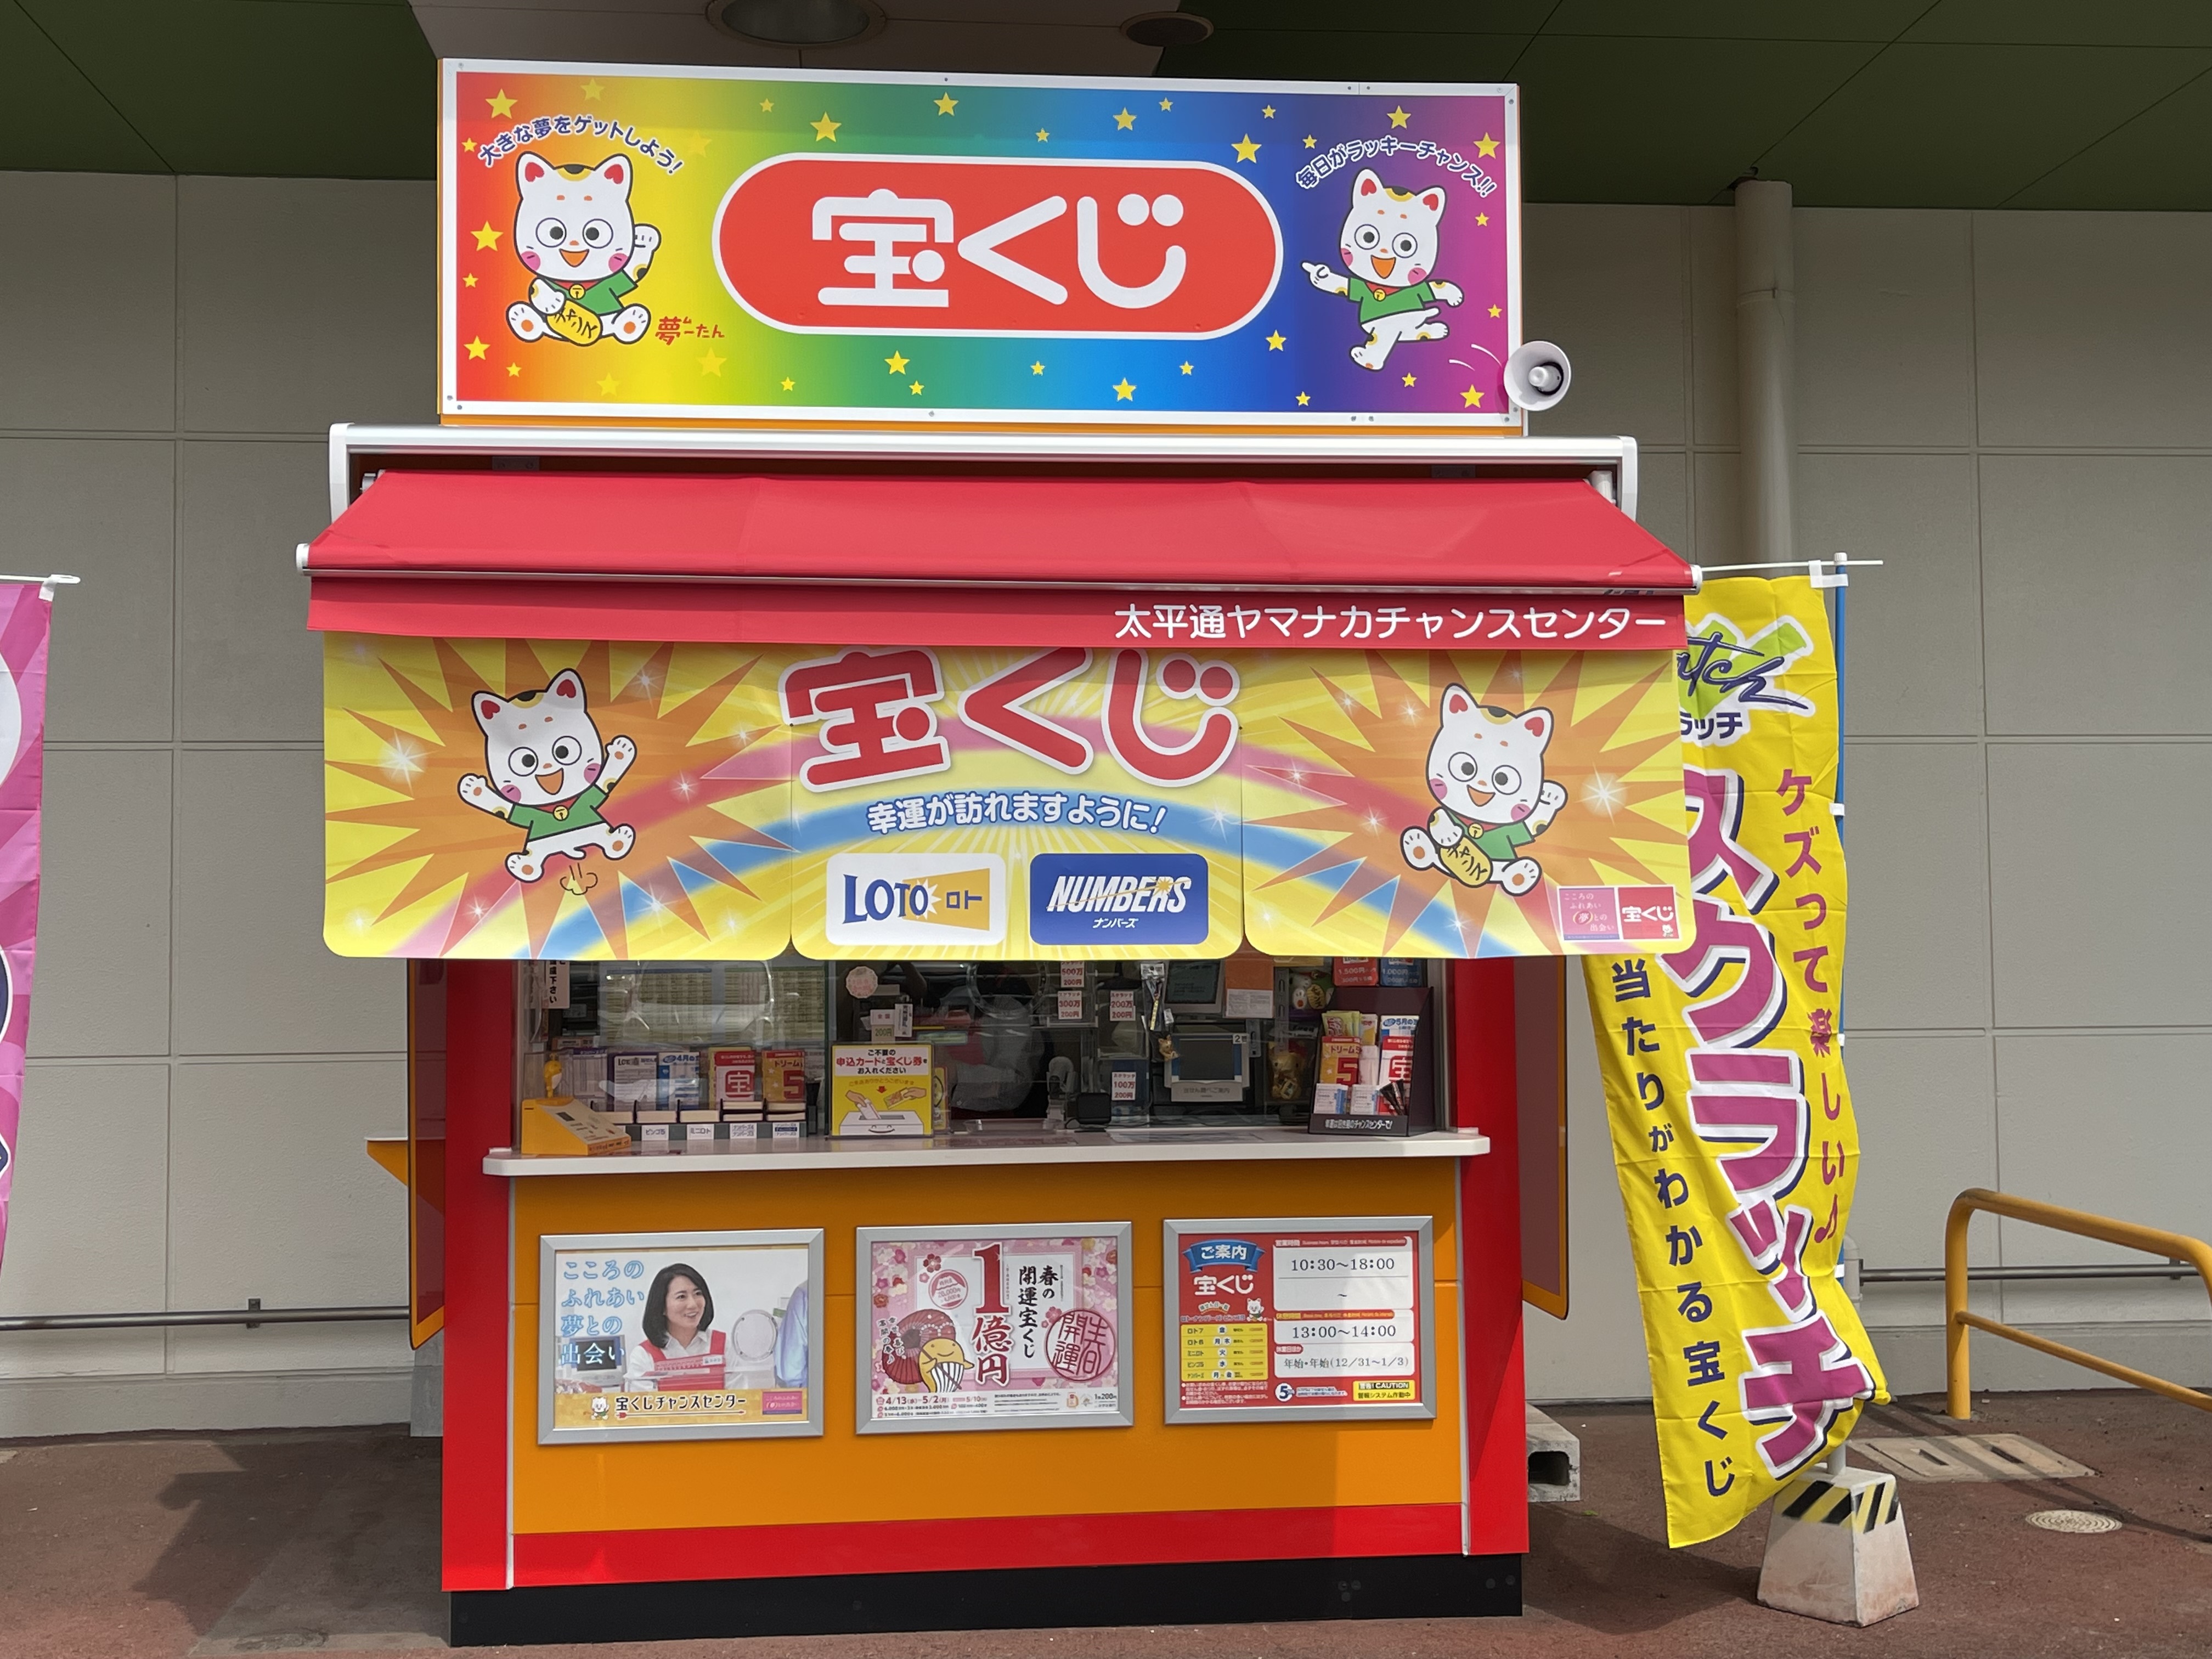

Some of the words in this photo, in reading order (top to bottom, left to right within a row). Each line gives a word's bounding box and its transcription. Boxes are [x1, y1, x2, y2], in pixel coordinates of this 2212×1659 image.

[477, 114, 685, 175] 大きな夢をゲットしよう!
[1295, 135, 1497, 199] 毎日がラッキーチャンス!!
[812, 189, 1186, 309] 宝くじ
[1114, 604, 1666, 640] 太平通ヤマナカチャンスセンター
[780, 647, 1241, 792] 宝くじ
[866, 791, 1167, 834] 幸運が訪れますように!
[842, 874, 928, 924] LOTO
[945, 889, 983, 910] ロト
[1046, 876, 1192, 913] NUMBERS
[1092, 917, 1139, 929] ナンバーズ
[1622, 906, 1674, 922] 宝くじ
[1612, 958, 1736, 1498] 当たりがわかる宝くじ
[562, 1260, 645, 1280] こころの
[1201, 1245, 1247, 1260] ご案内
[561, 1288, 645, 1308] ふれあい
[1040, 1265, 1059, 1299] 春の
[1194, 1274, 1254, 1296] 宝くじ
[561, 1315, 623, 1337] 夢との
[973, 1243, 1011, 1385] 1億円
[1019, 1266, 1039, 1359] 開運宝くじ
[561, 1343, 625, 1365] 出会い
[615, 1394, 746, 1412] 宝くじチャンスセンター
